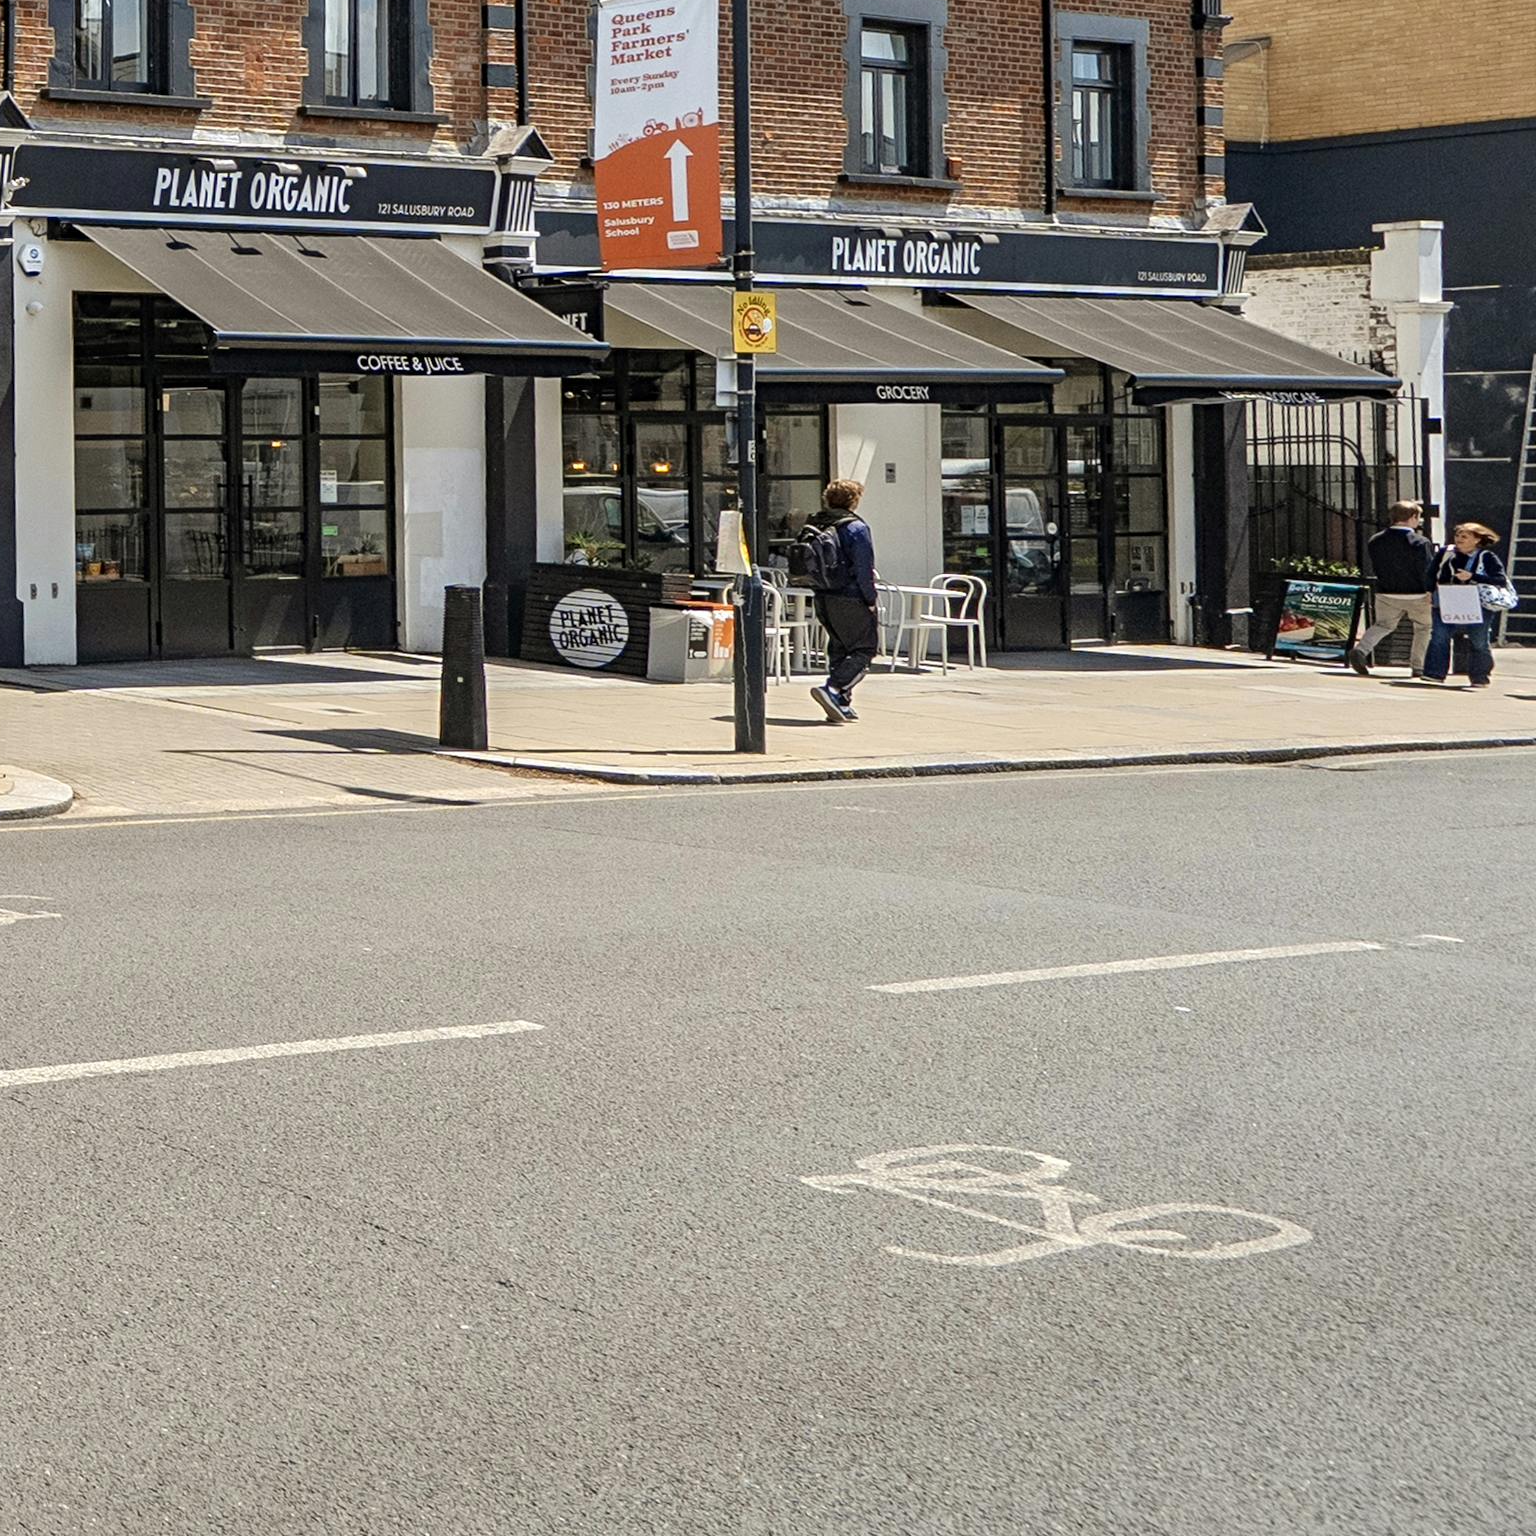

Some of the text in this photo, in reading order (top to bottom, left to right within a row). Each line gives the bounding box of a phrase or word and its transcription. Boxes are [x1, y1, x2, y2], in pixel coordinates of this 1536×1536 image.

[612, 6, 676, 25] Queens
[612, 23, 652, 39] Park
[612, 28, 690, 52] Farmers'
[611, 46, 672, 65] Market
[610, 70, 680, 86] Every Sunday
[153, 167, 354, 214] PLANET ORGANIC
[378, 202, 475, 218] 121 SALUSBURY ROAD
[603, 197, 664, 210] 130 METERS
[604, 216, 655, 227] Salusbury
[605, 227, 640, 238] School
[832, 236, 981, 275] PLANET ORGANIC
[1148, 271, 1186, 282] SALUSBURY
[1187, 272, 1207, 282] ROAD
[736, 302, 749, 315] No
[357, 355, 464, 375] COFFEE & JUICE
[876, 385, 930, 400] GROCERY
[1302, 593, 1352, 606] Season
[560, 604, 613, 628] PLANET
[559, 624, 624, 649] ORGANIC
